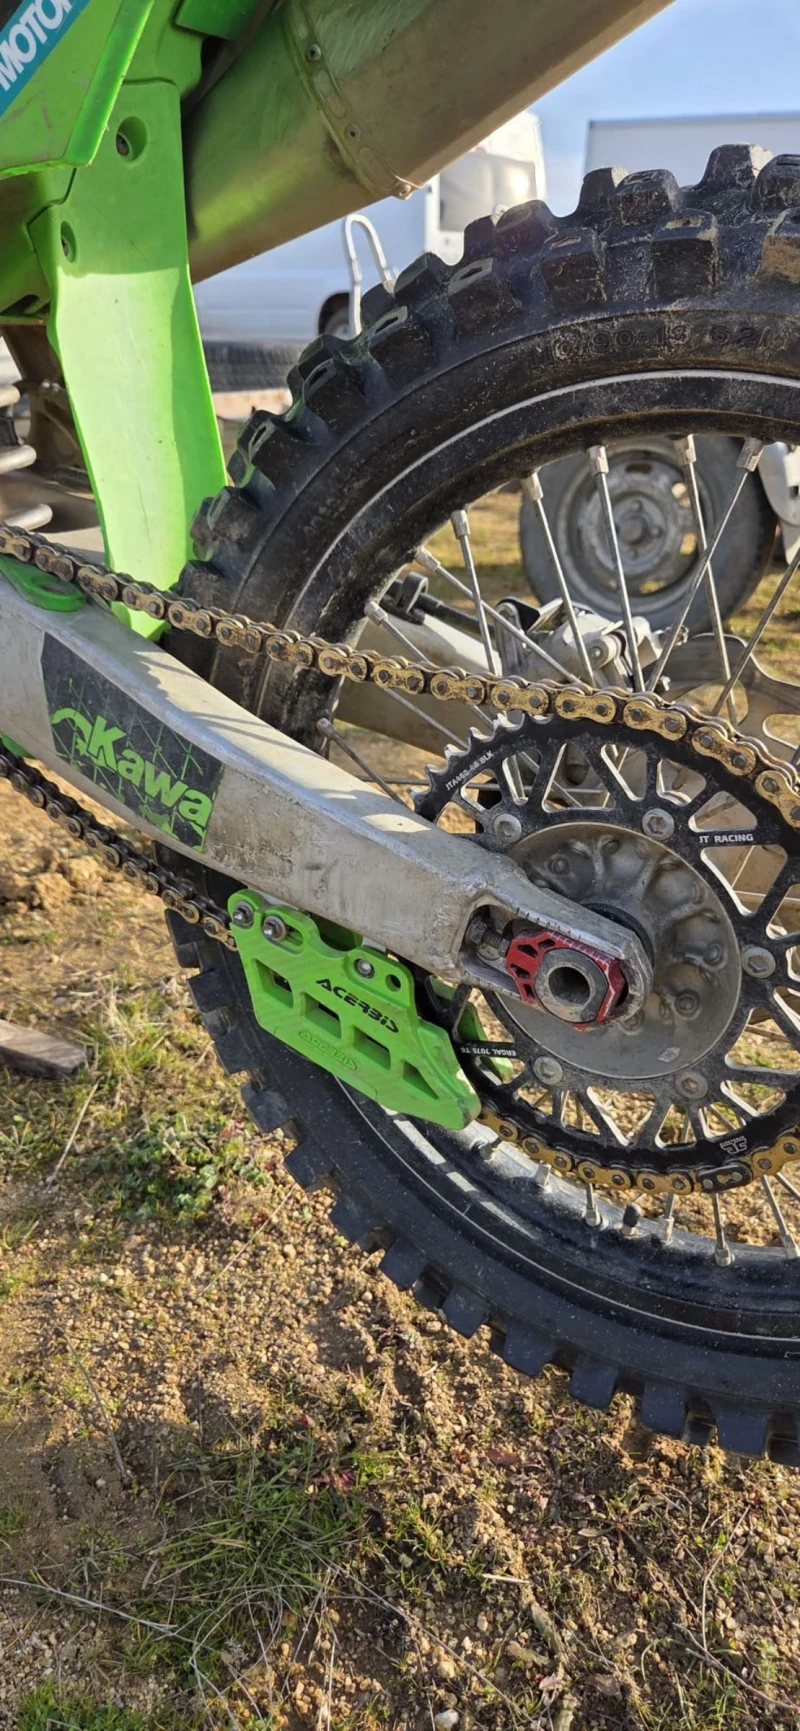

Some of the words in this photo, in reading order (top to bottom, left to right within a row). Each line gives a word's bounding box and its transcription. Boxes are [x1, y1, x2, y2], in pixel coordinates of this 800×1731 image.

[699, 835, 710, 843] JT
[714, 833, 754, 843] RACING
[315, 978, 399, 1034] ACERBIS
[472, 1047, 491, 1055] 7075
[492, 1048, 517, 1057] ERGAL
